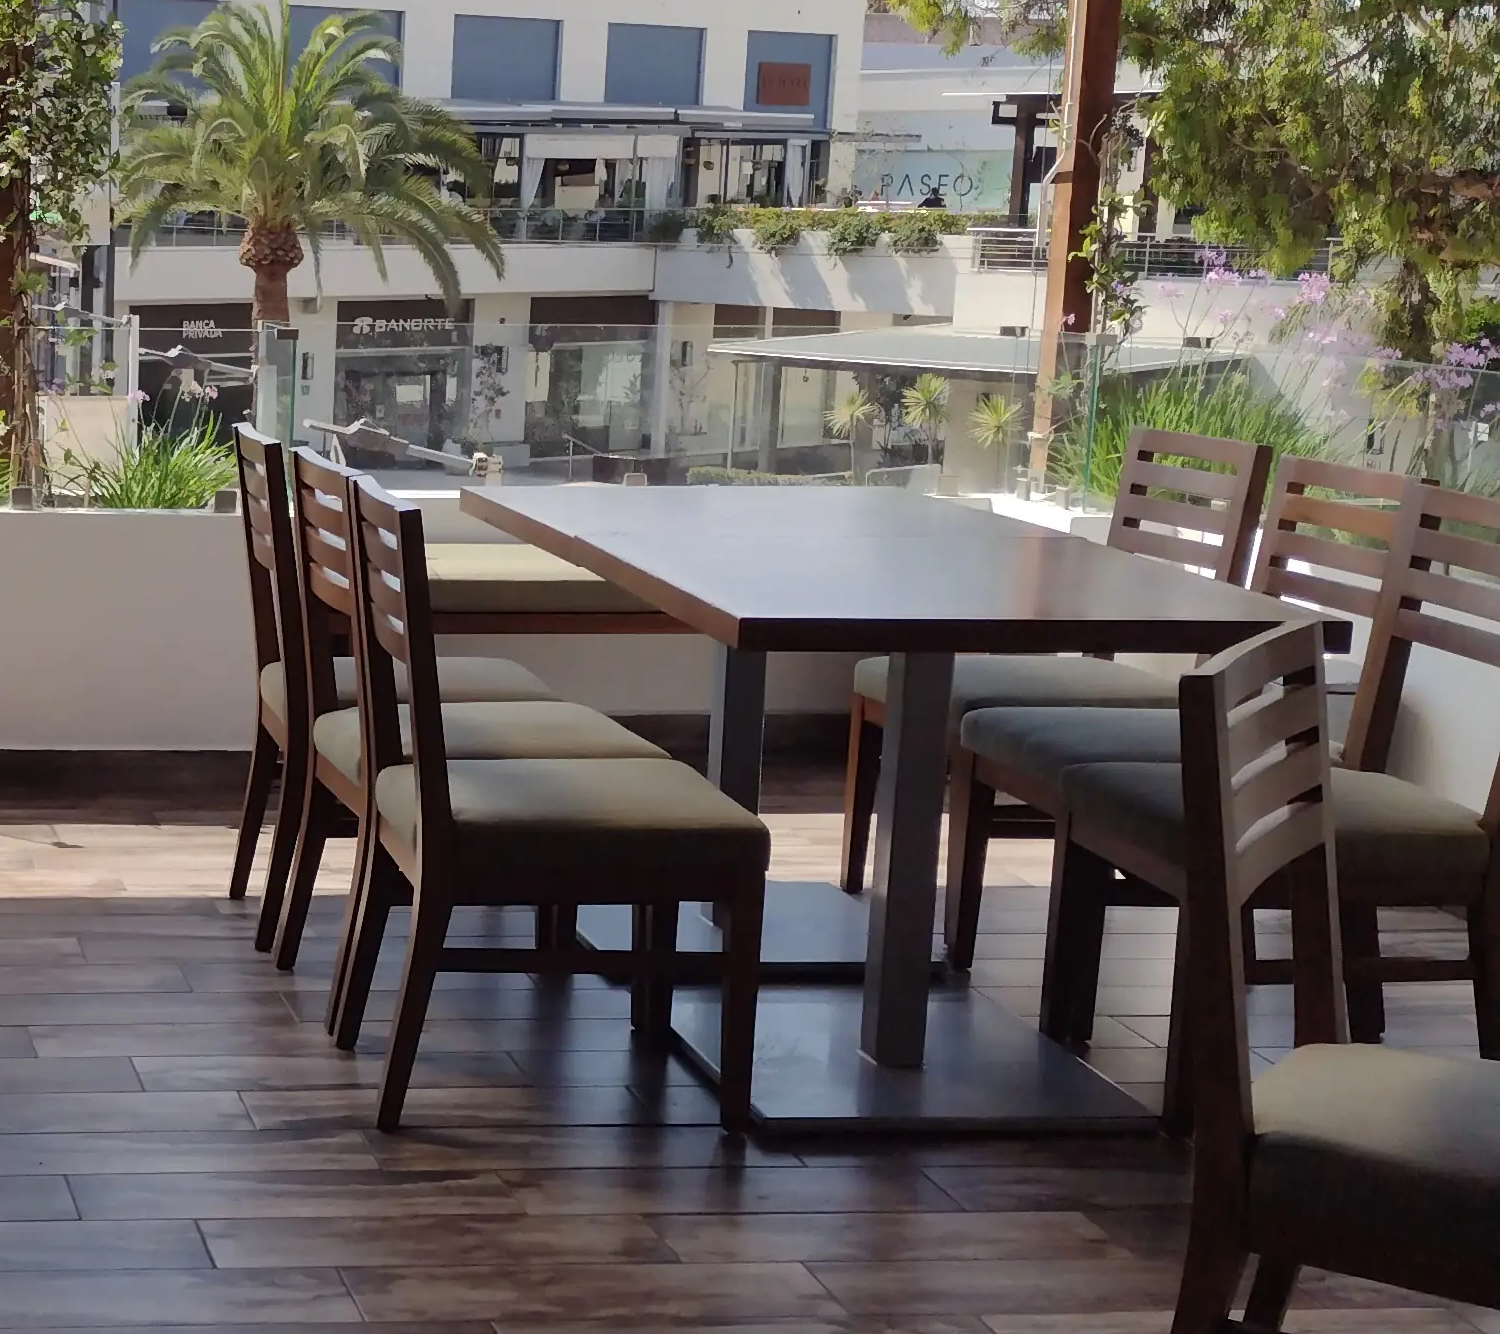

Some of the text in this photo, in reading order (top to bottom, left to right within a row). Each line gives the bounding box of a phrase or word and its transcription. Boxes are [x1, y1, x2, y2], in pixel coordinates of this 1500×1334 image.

[880, 173, 974, 196] PASEO
[182, 319, 216, 329] BANCA
[375, 317, 455, 333] BANORTE
